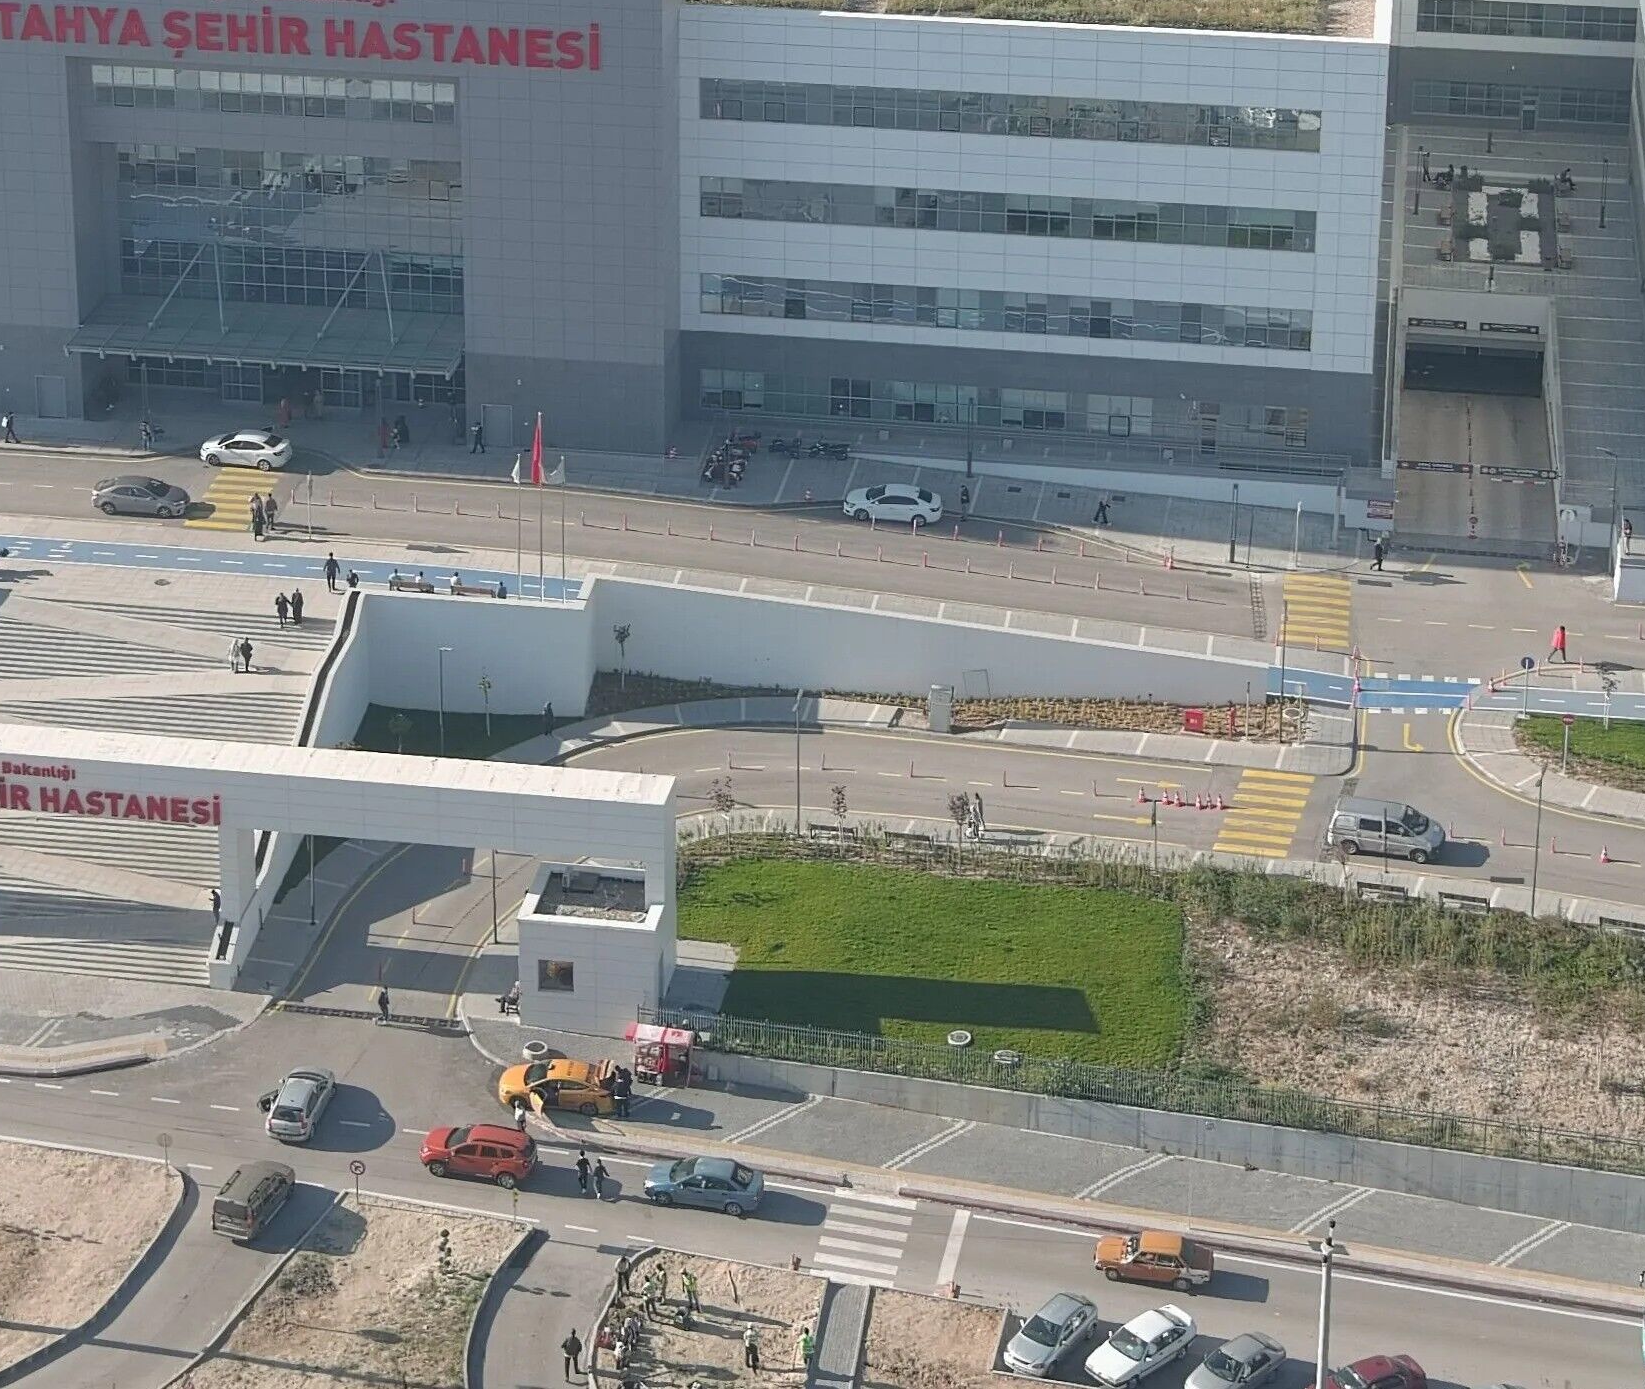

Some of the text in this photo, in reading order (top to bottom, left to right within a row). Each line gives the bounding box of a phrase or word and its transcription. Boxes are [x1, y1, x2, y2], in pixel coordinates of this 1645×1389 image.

[163, 5, 312, 59] ŞEHİR
[324, 18, 601, 71] HASTANESİ
[2, 760, 76, 781] Bakanlığı
[39, 786, 222, 826] HASTANESİ
